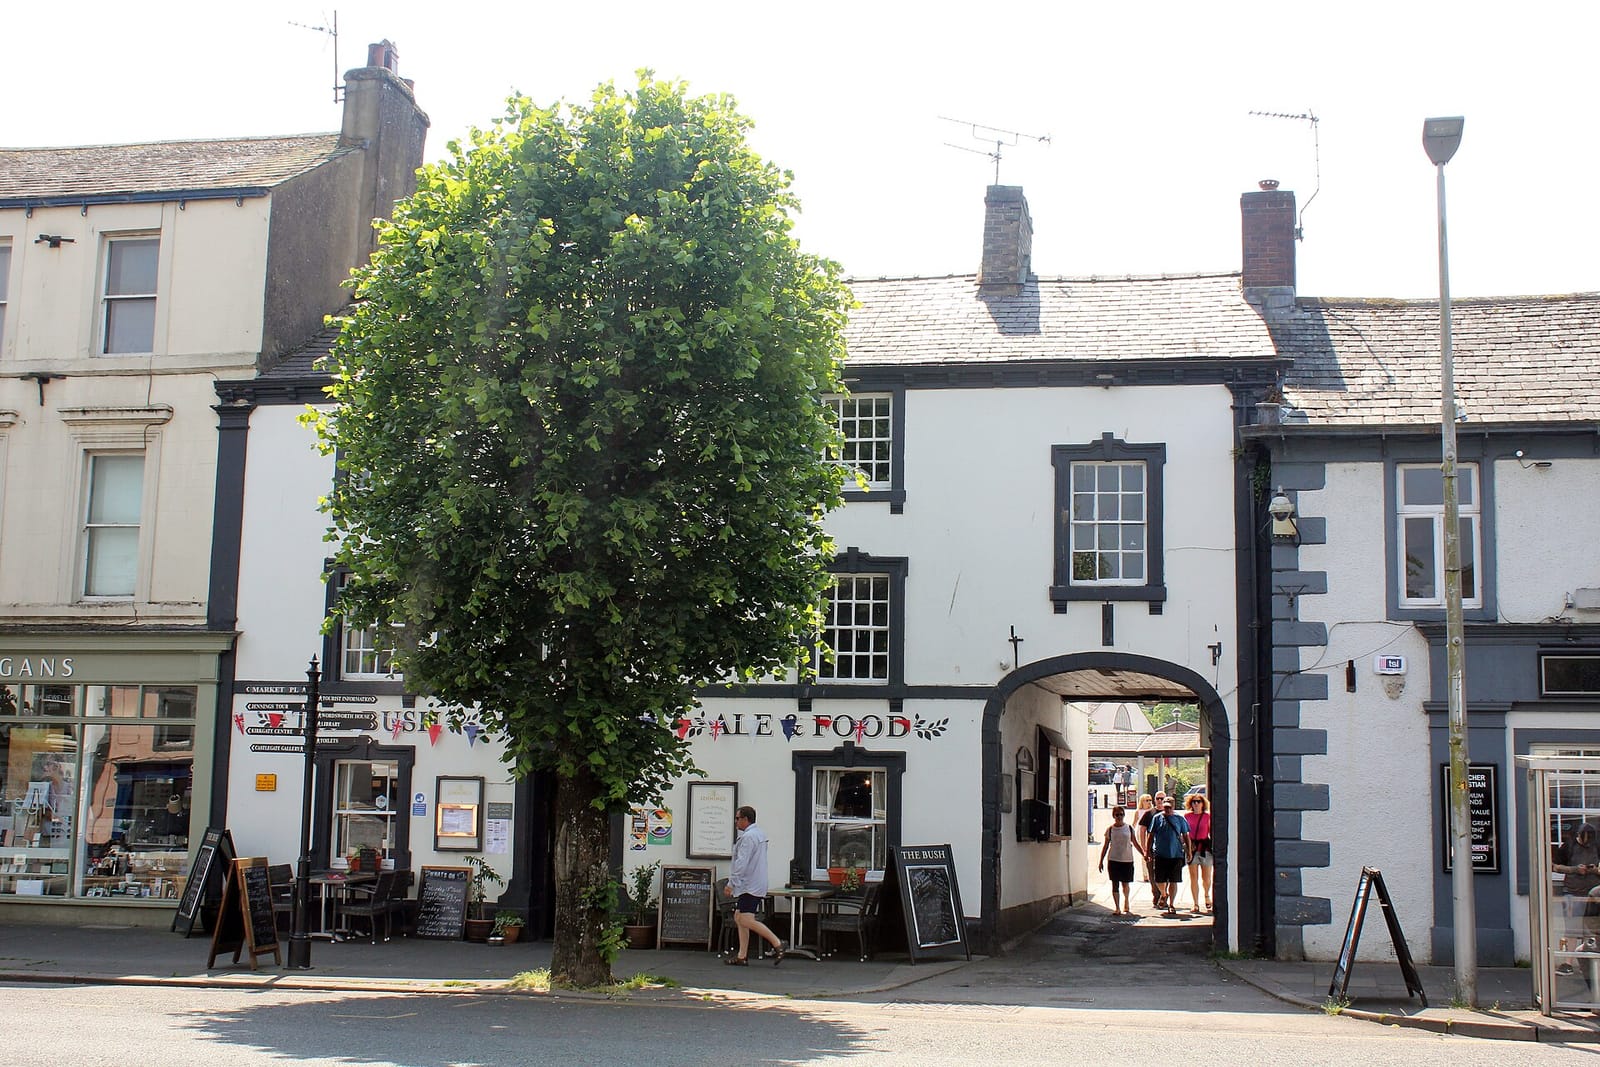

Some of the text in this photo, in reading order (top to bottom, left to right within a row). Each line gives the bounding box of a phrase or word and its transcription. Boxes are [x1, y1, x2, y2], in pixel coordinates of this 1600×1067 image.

[0, 658, 74, 677] GANS
[251, 686, 299, 694] MARKET PL
[370, 710, 441, 733] USH
[709, 713, 774, 738] ALE
[813, 713, 910, 738] FOOD
[901, 850, 945, 860] THE BUSH
